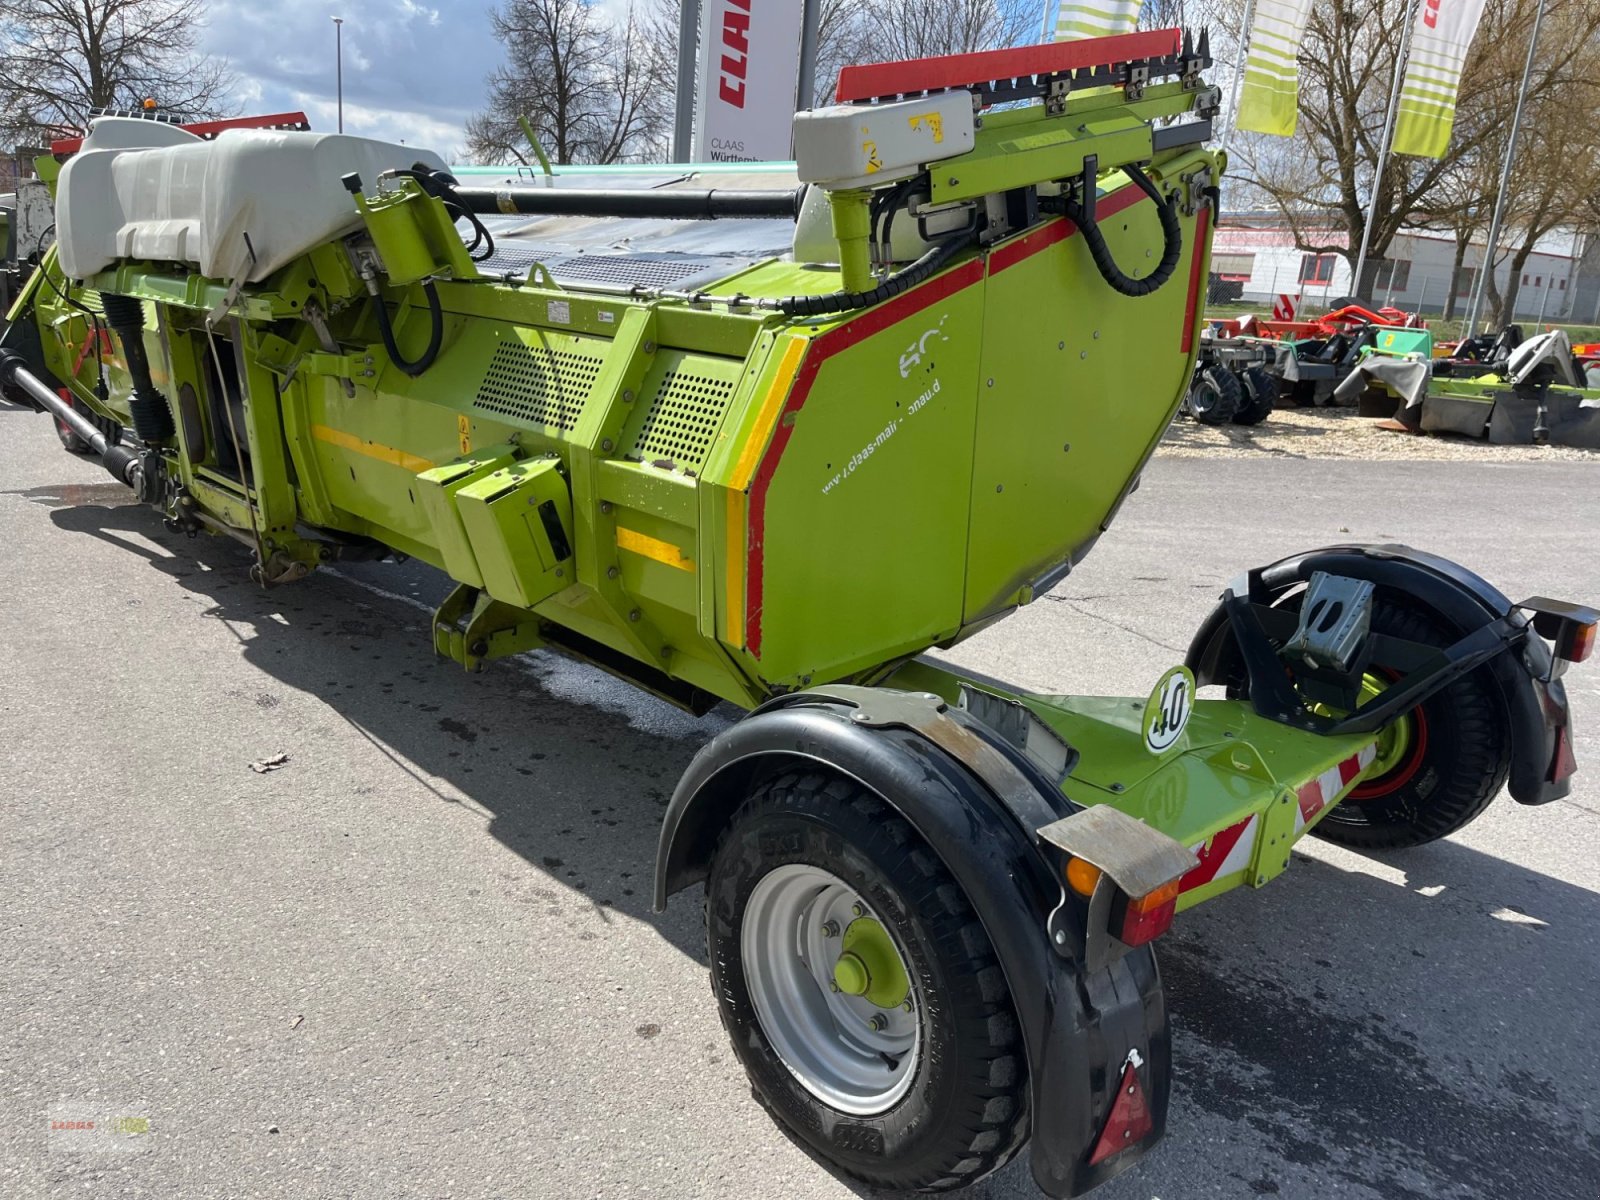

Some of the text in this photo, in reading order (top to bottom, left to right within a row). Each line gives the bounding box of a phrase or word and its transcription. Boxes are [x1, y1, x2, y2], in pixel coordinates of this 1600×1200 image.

[719, 0, 751, 109] CLA
[711, 138, 744, 151] CLAAS
[711, 151, 764, 162] Württemb
[1153, 682, 1185, 738] 40
